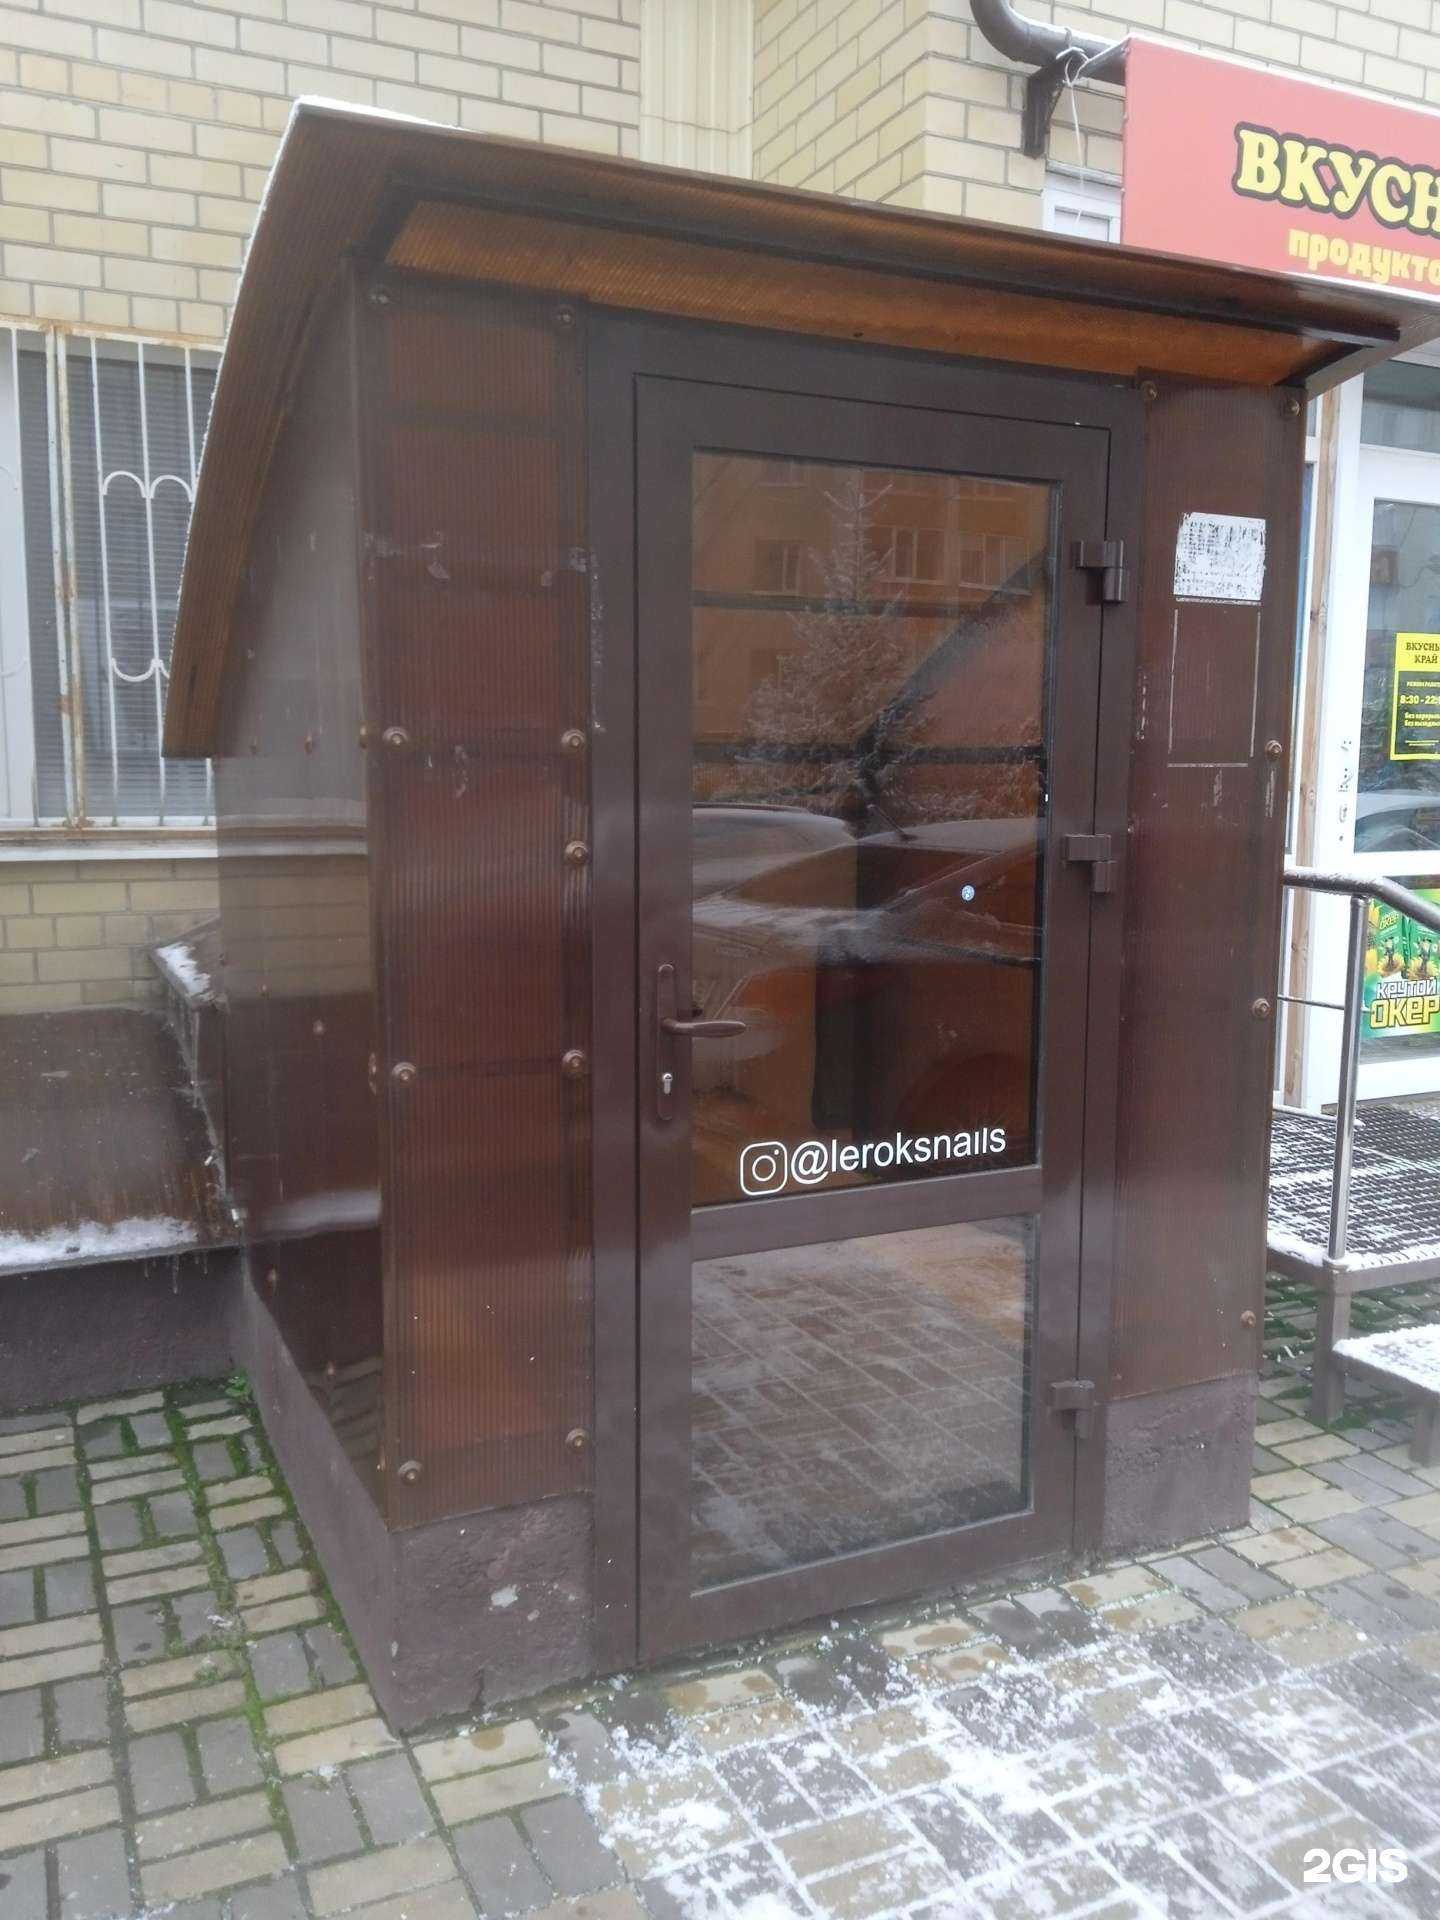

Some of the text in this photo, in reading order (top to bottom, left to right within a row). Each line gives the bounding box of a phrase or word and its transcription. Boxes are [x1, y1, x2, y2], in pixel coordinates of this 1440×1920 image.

[1232, 121, 1440, 238] ВКУСН
[1288, 228, 1440, 286] продукто
[1414, 654, 1438, 664] КРАЙ
[1400, 694, 1419, 705] 8:30
[1425, 695, 1440, 705] 22:
[1376, 977, 1437, 999] КРУТОЙ
[1370, 995, 1440, 1029] ОКЕР
[790, 1127, 1007, 1185] @leroksnails
